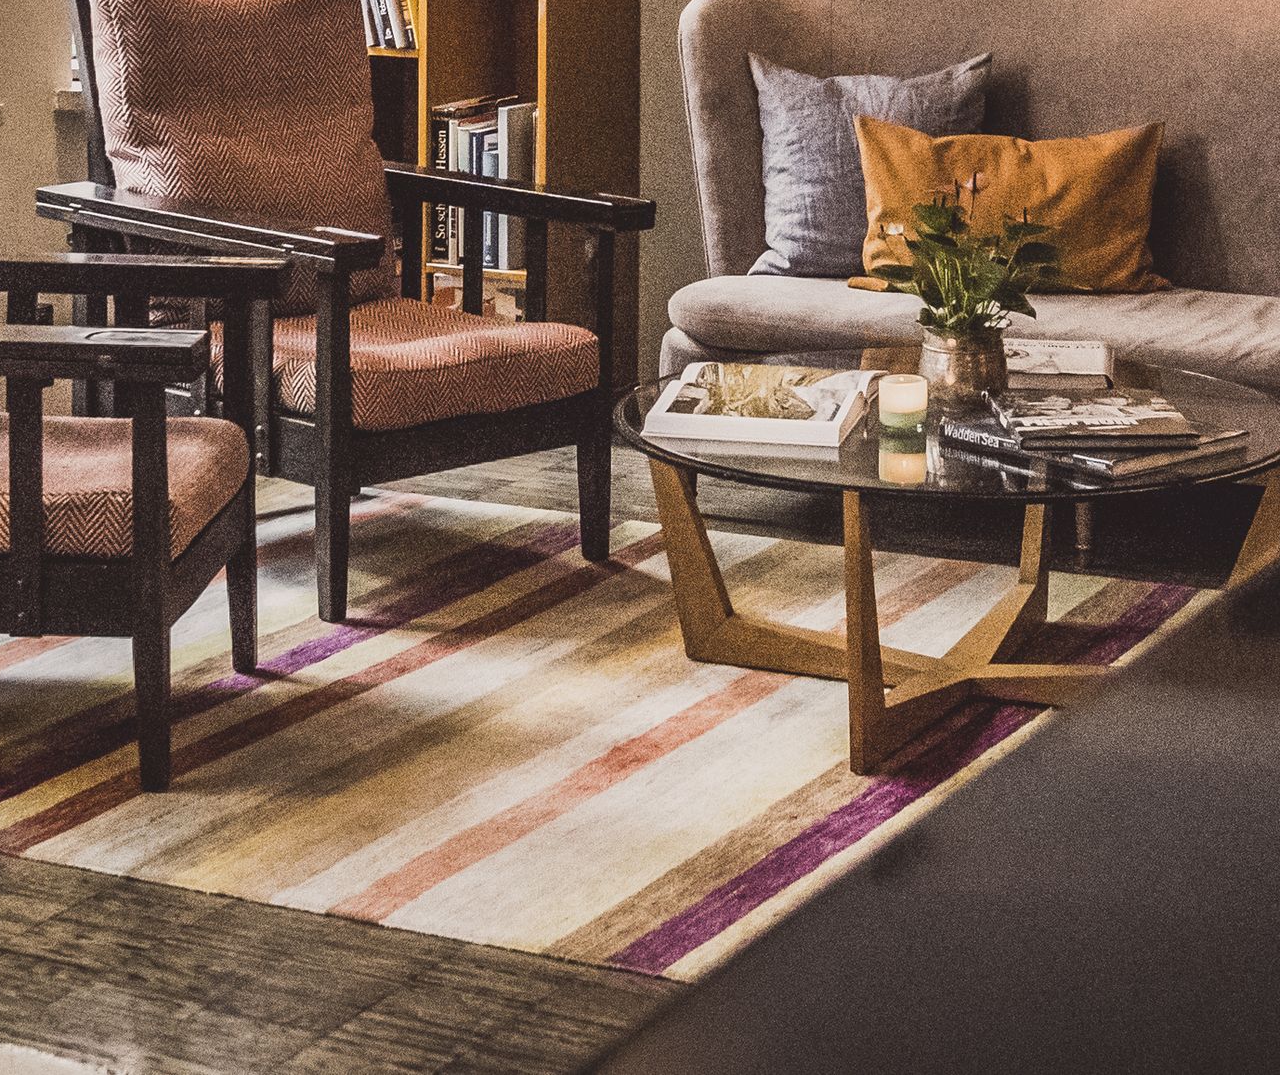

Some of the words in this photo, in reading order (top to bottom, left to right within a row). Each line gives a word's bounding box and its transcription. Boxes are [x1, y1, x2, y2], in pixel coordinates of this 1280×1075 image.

[435, 129, 447, 170] Hessen
[435, 222, 446, 240] So
[943, 424, 981, 444] Wadden
[981, 432, 1000, 448] Sea
